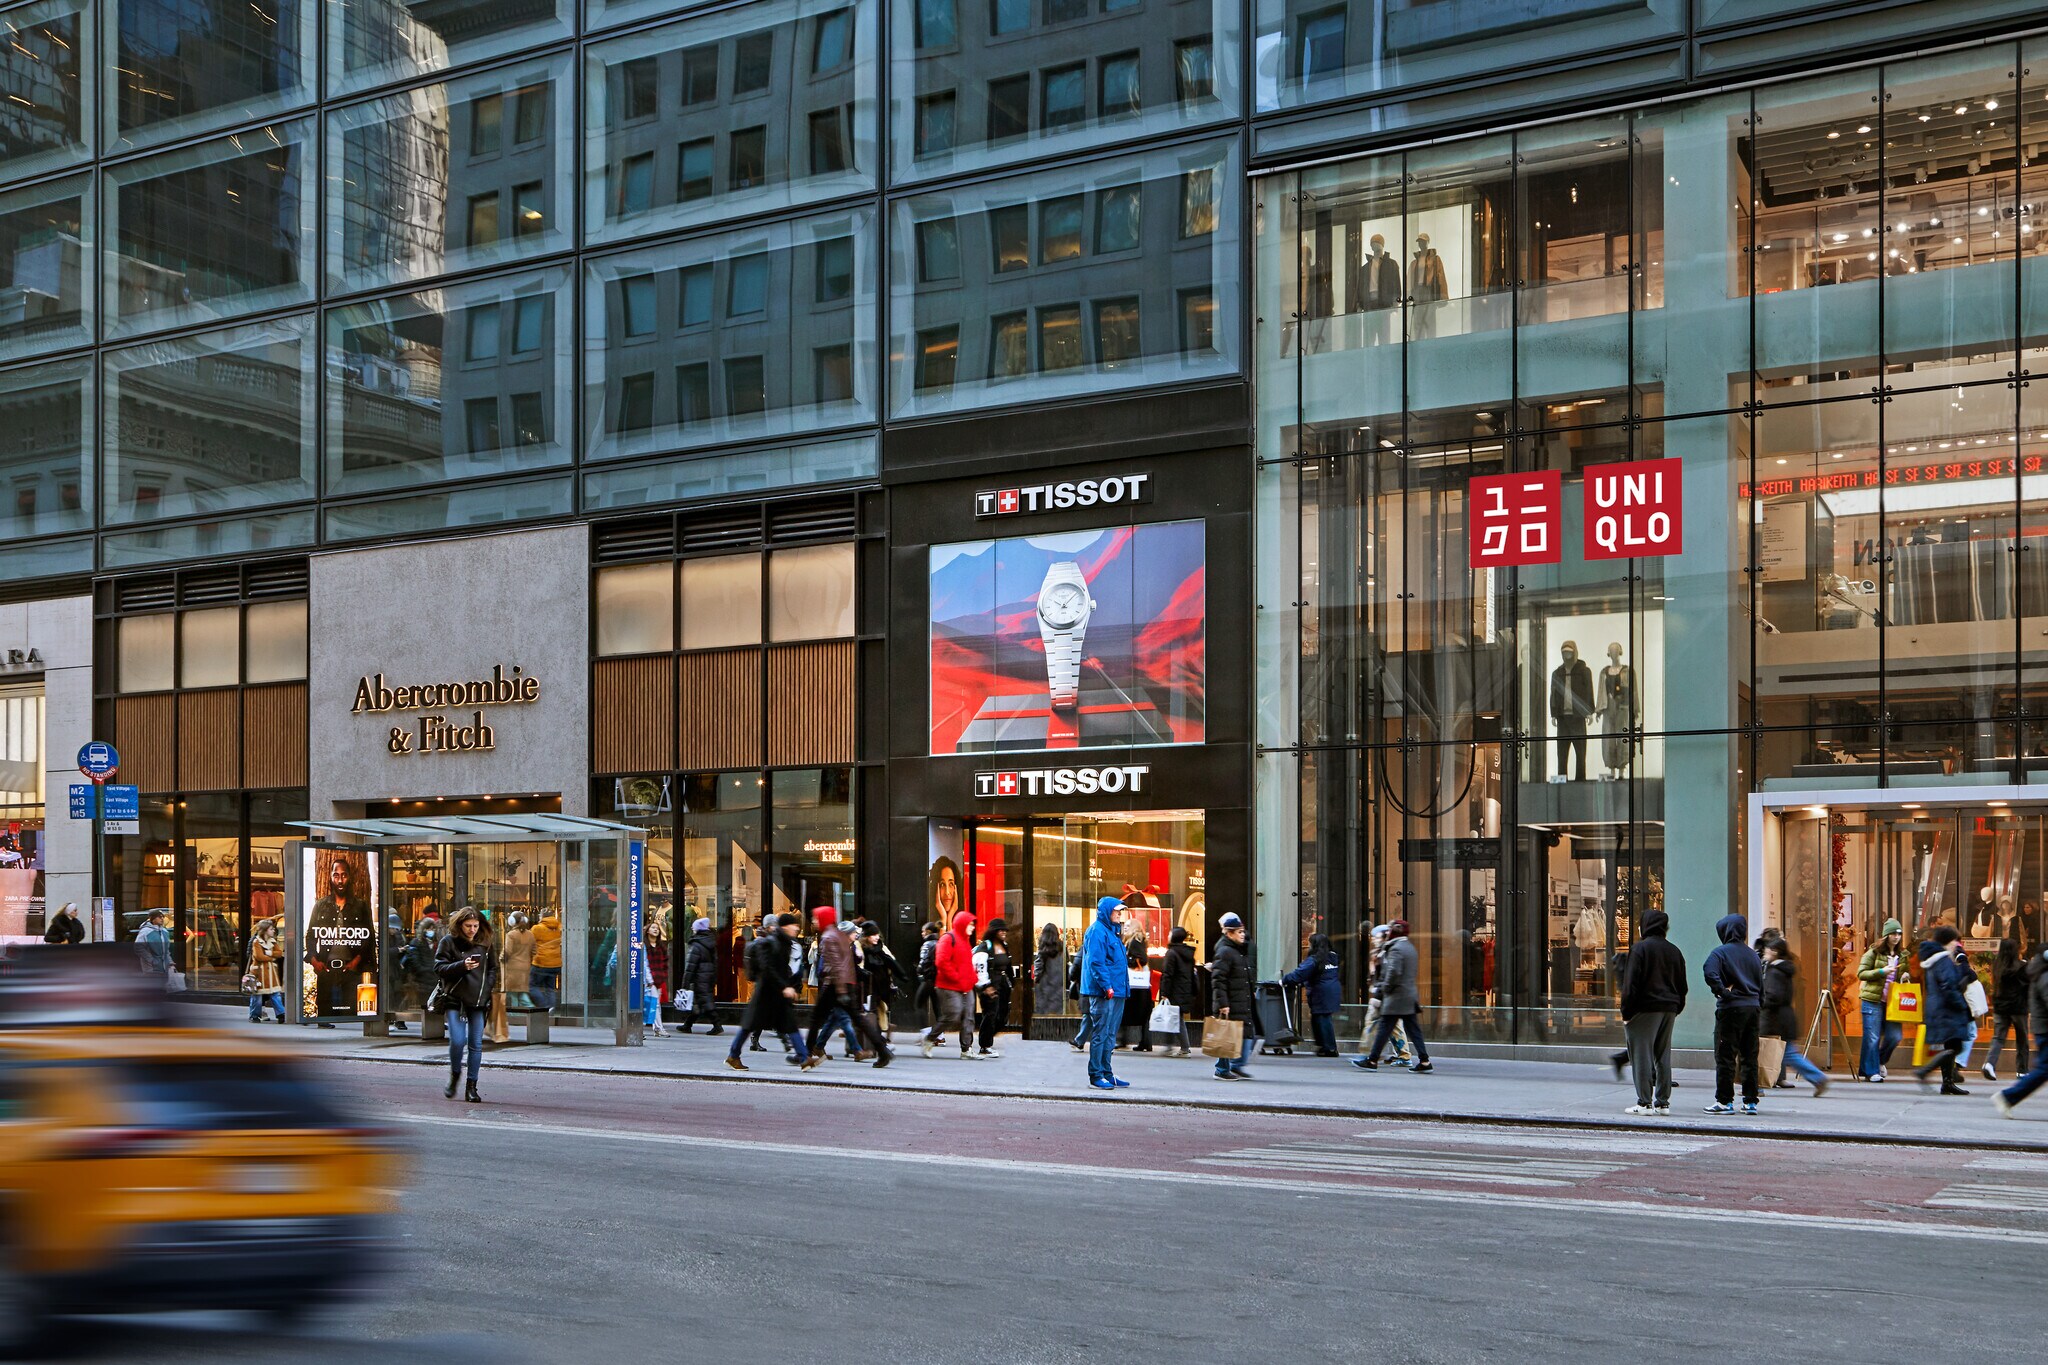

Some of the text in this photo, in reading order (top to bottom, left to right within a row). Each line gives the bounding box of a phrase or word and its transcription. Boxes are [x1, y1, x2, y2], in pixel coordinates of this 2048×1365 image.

[1021, 474, 1148, 511] TISSOT
[1483, 483, 1547, 517] ユニ
[1595, 471, 1663, 508] UNI
[1481, 522, 1547, 556] クロ
[1595, 511, 1671, 552] QLO
[0, 648, 44, 666] RA
[351, 664, 540, 713] Abercrombie
[388, 711, 496, 754] & Fitch
[90, 767, 116, 778] STANDING
[1020, 766, 1149, 796] TISSOT
[71, 787, 84, 795] M2
[71, 798, 85, 806] M3
[72, 809, 85, 817] M5
[822, 850, 842, 862] kids
[311, 926, 370, 939] TOM FORD
